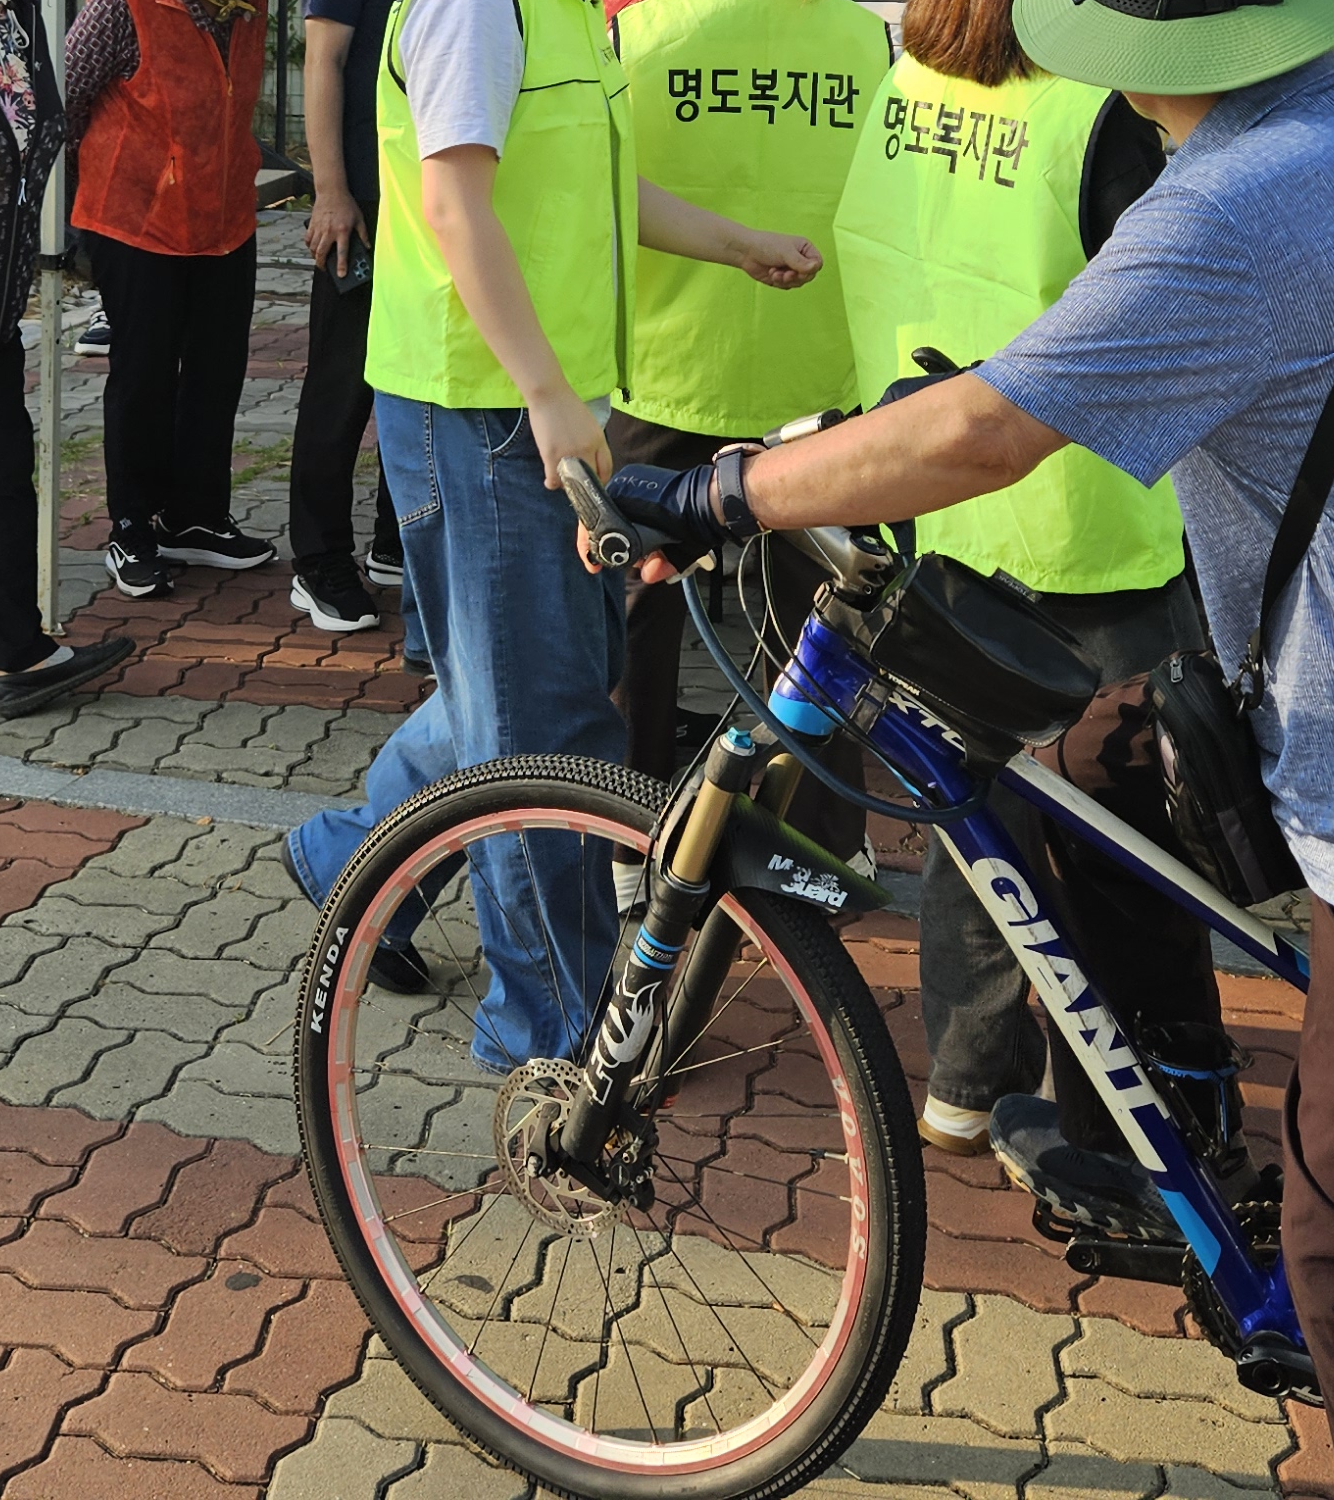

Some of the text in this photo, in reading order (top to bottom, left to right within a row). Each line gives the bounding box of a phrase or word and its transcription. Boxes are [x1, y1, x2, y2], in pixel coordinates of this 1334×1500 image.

[668, 68, 860, 130] 명도복지관
[884, 96, 1029, 188] 명도복지관
[887, 673, 921, 696] TOPEAK
[310, 926, 349, 1034] KENDA
[972, 857, 1171, 1124] GIANT
